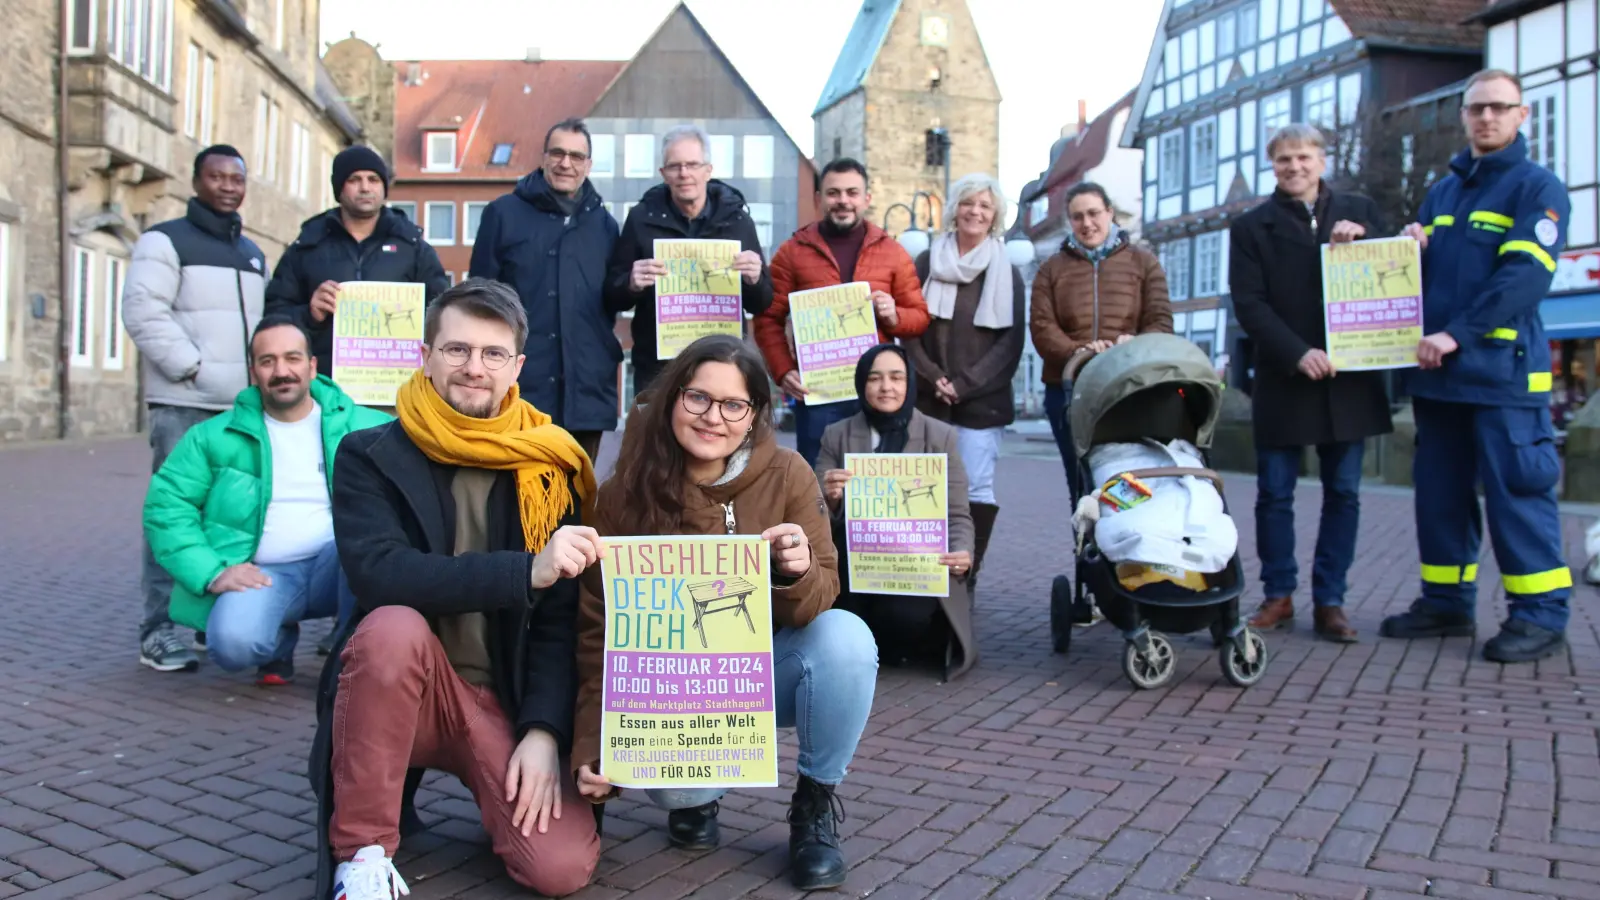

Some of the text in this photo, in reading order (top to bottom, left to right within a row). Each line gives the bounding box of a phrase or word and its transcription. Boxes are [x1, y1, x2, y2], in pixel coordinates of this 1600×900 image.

[661, 275, 699, 293] DICH
[851, 458, 942, 476] TISCHLEIN
[851, 477, 896, 496] DECK
[852, 498, 897, 517] DICH
[851, 521, 942, 532] 10. FEBRUAR 2024
[852, 533, 942, 543] 10:00 bis 13:00 Uhr
[609, 544, 760, 575] TISCHLEIN
[613, 578, 686, 610] DECK
[613, 613, 685, 650] DICH
[613, 656, 763, 674] 10. FEBRUAR 2024
[612, 677, 764, 694] 10:00 bis 13:00 Uhr
[611, 698, 765, 711] auf dem Marktplatz Stadthagen!
[620, 714, 755, 729] Essen aus aller Welt
[611, 733, 766, 748] gegen eine Spende für die
[613, 748, 764, 763] KREISJUGENDFEUERWEHR
[633, 764, 745, 778] UND FÜR DAS THW.
